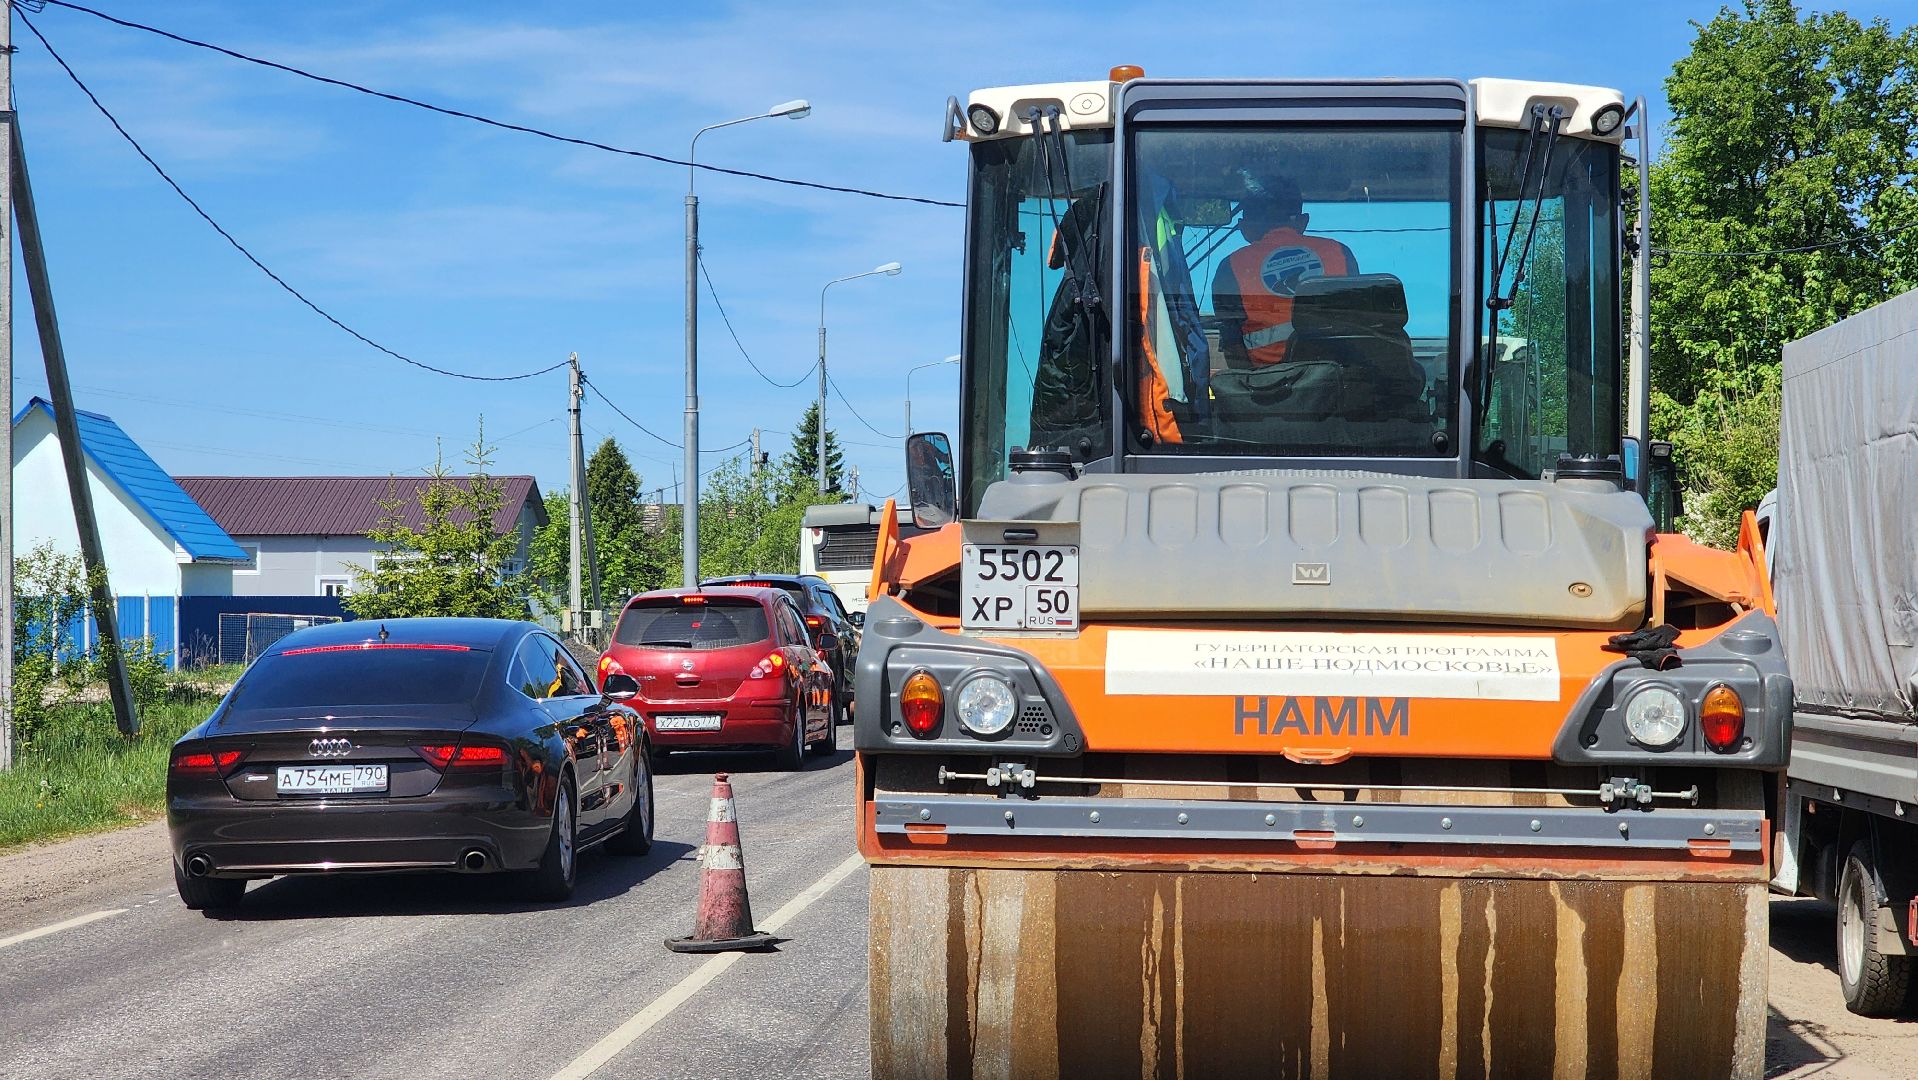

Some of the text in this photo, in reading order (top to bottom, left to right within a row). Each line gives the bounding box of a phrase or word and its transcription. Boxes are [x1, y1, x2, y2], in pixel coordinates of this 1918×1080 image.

[978, 548, 1064, 582] 5502
[1036, 589, 1070, 614] 50
[1029, 616, 1054, 625] RUS
[1194, 643, 1549, 658] ГУБЕРНАТОРСКАЯ ПРОГРАММА
[1194, 657, 1553, 677] «НАШЕ ПОДМОСКОВЬЕ»
[1234, 695, 1409, 736] HAMM
[355, 767, 383, 780] 790
